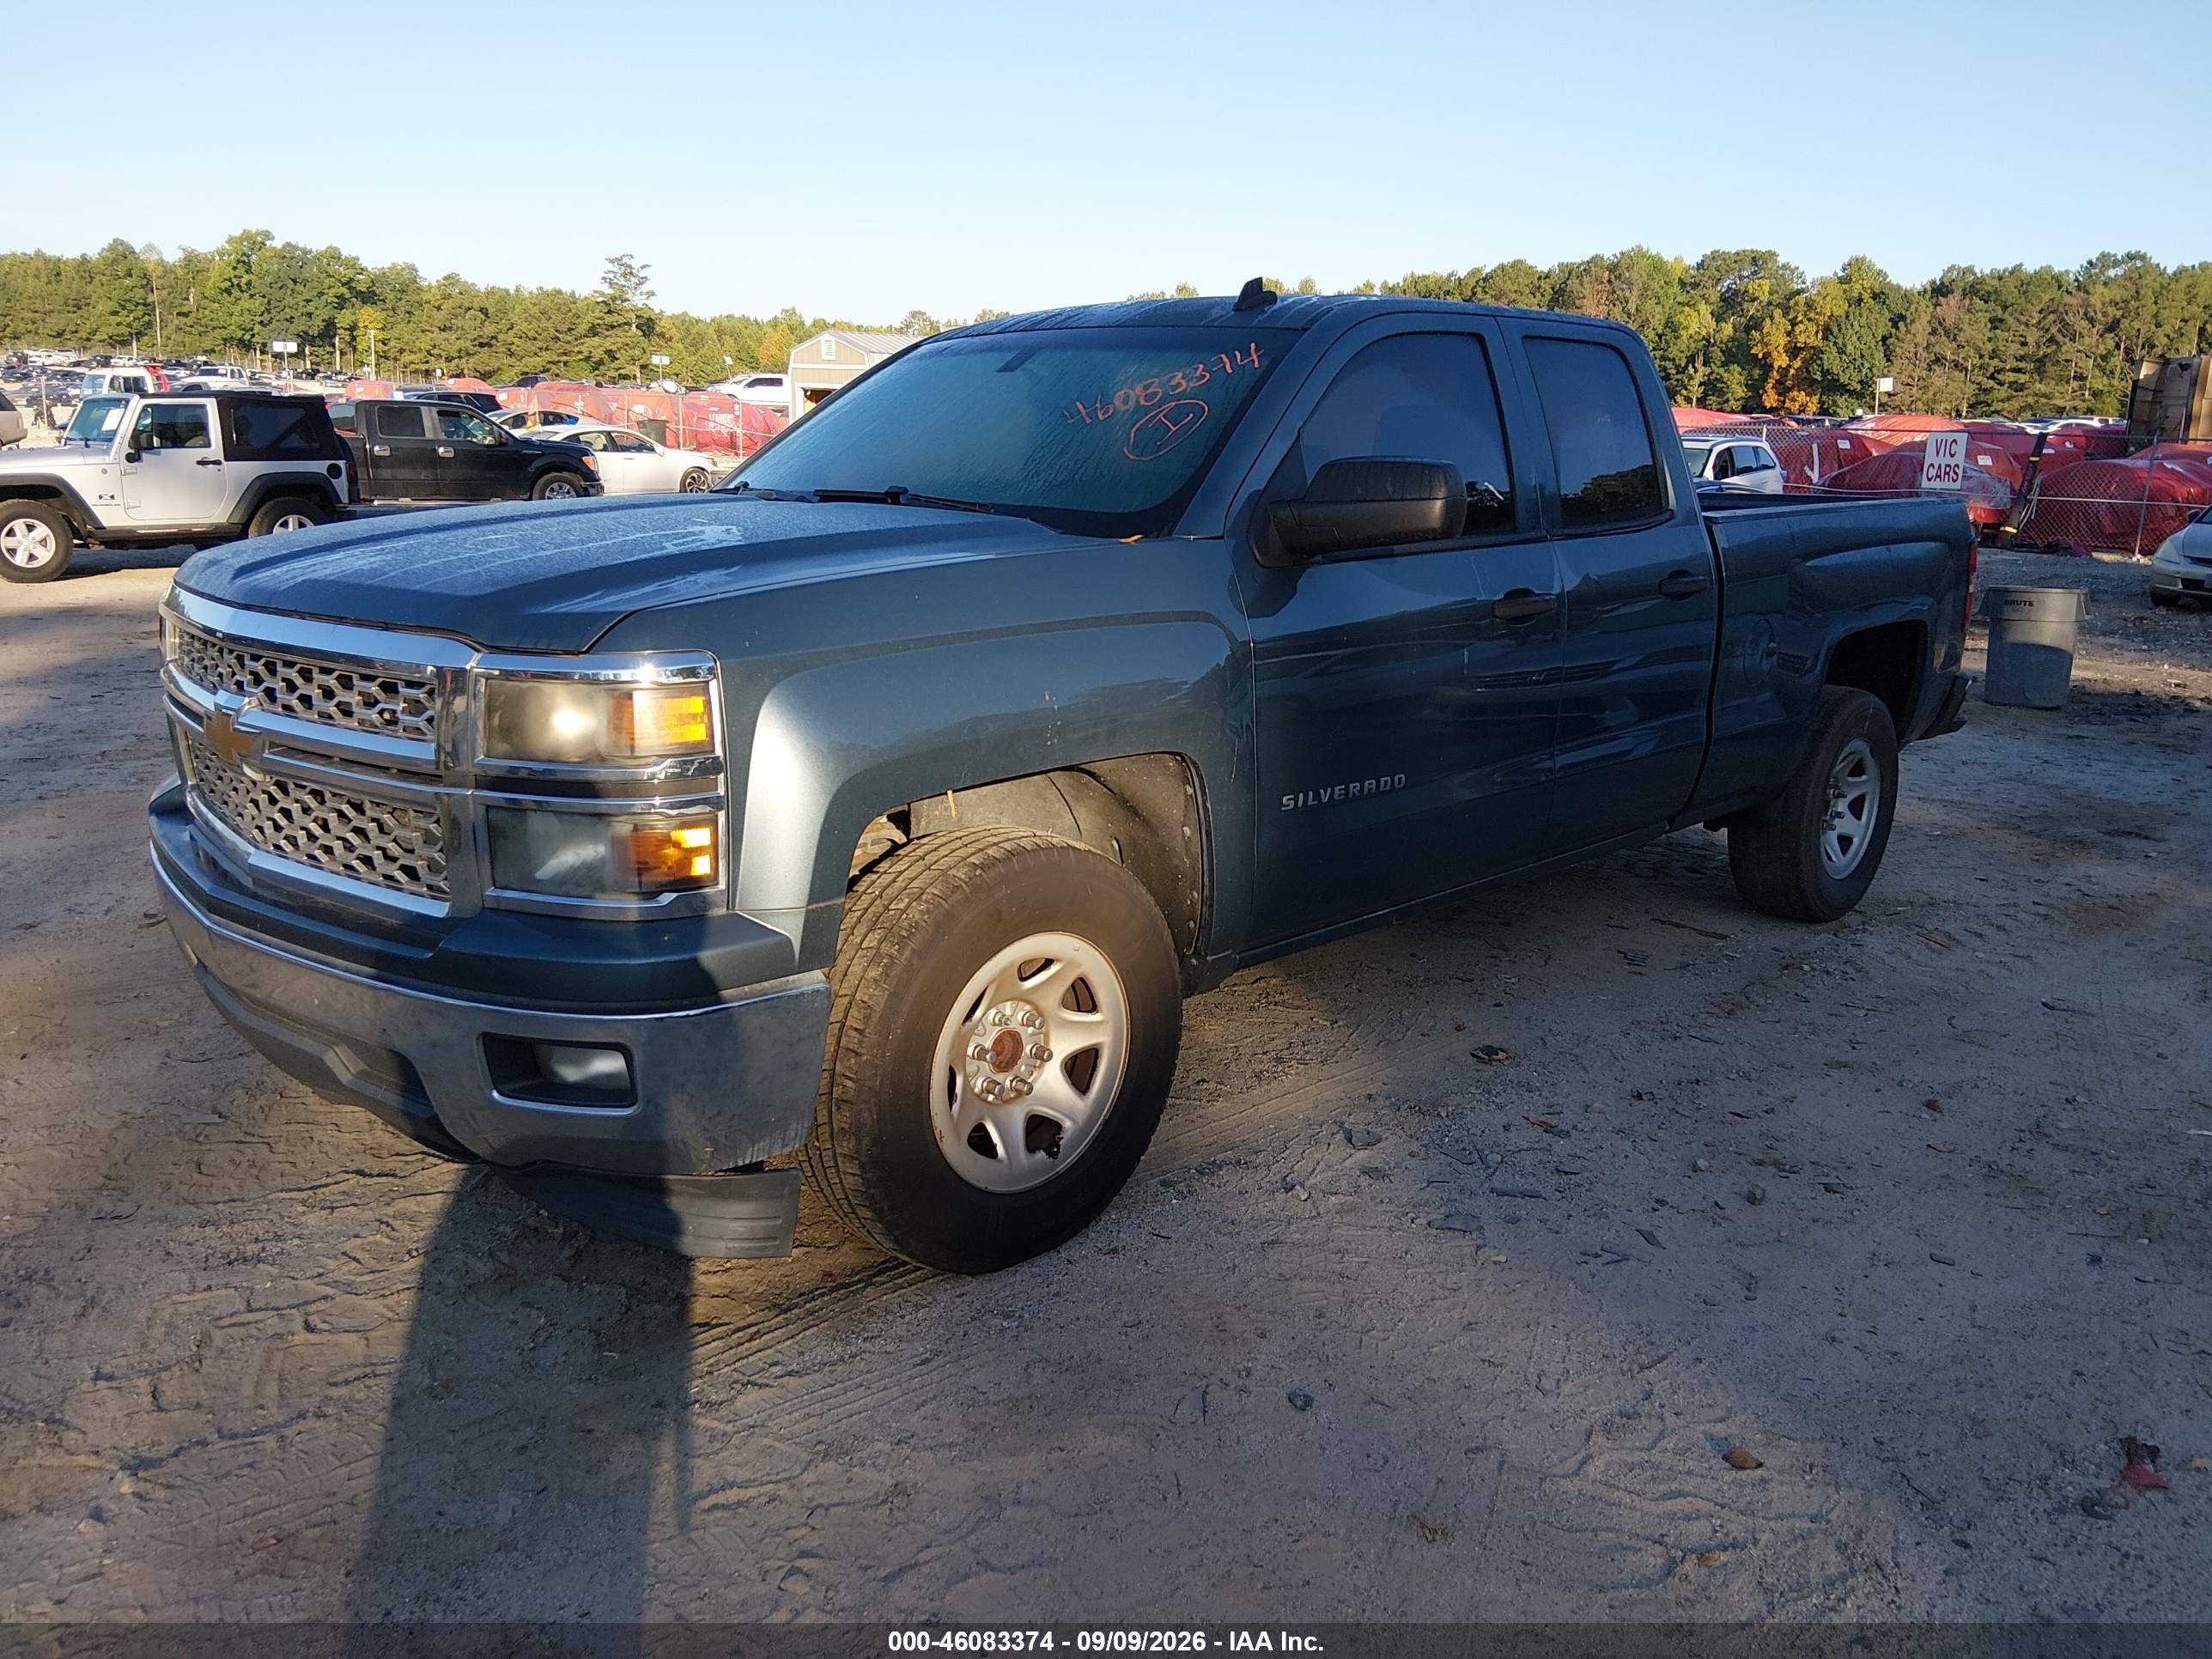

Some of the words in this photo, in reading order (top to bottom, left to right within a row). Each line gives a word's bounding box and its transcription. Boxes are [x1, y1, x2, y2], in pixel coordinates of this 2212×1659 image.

[1063, 342, 1265, 424] 46083374
[1936, 438, 1958, 459] VIC
[1926, 462, 1960, 483] CARS
[1280, 774, 1406, 811] SILVERADO
